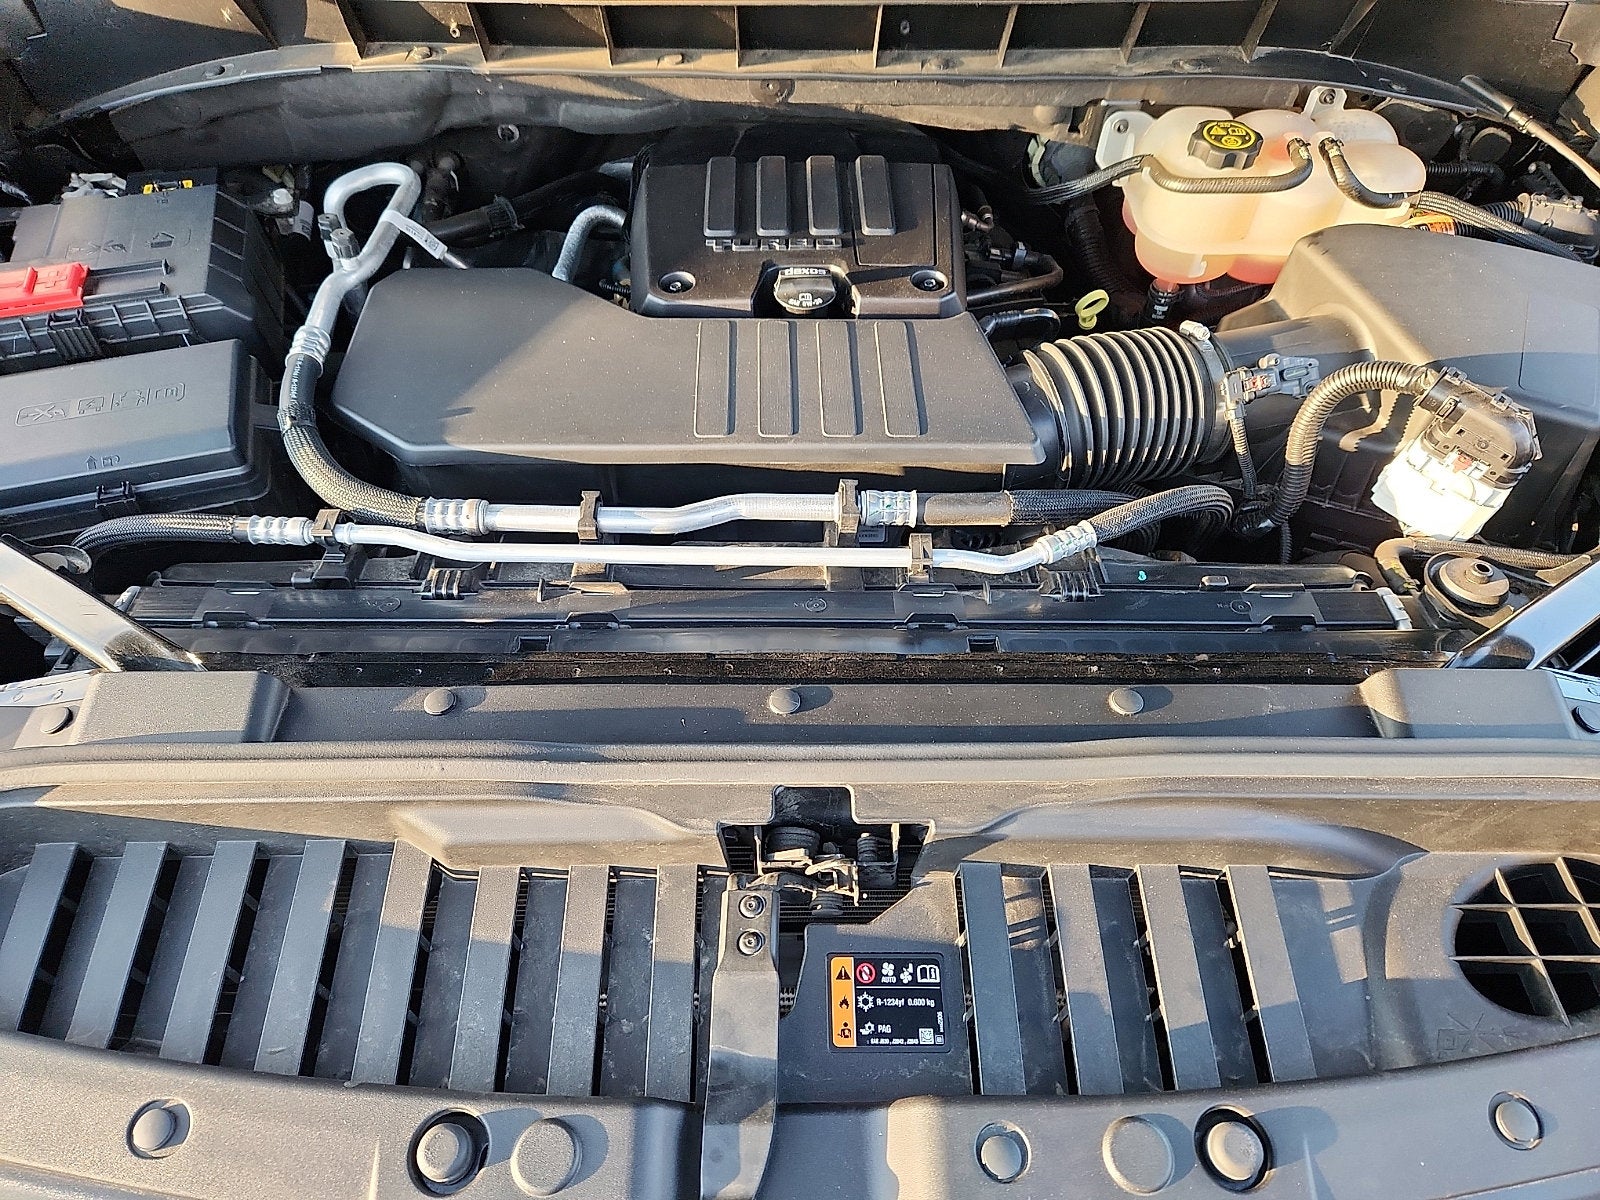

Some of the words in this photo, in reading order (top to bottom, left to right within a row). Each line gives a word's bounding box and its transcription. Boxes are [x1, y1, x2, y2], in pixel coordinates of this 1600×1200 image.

[784, 267, 827, 276] dexos
[876, 998, 905, 1008] R-1234yf
[926, 998, 935, 1008] kg
[877, 1024, 892, 1034] PAG
